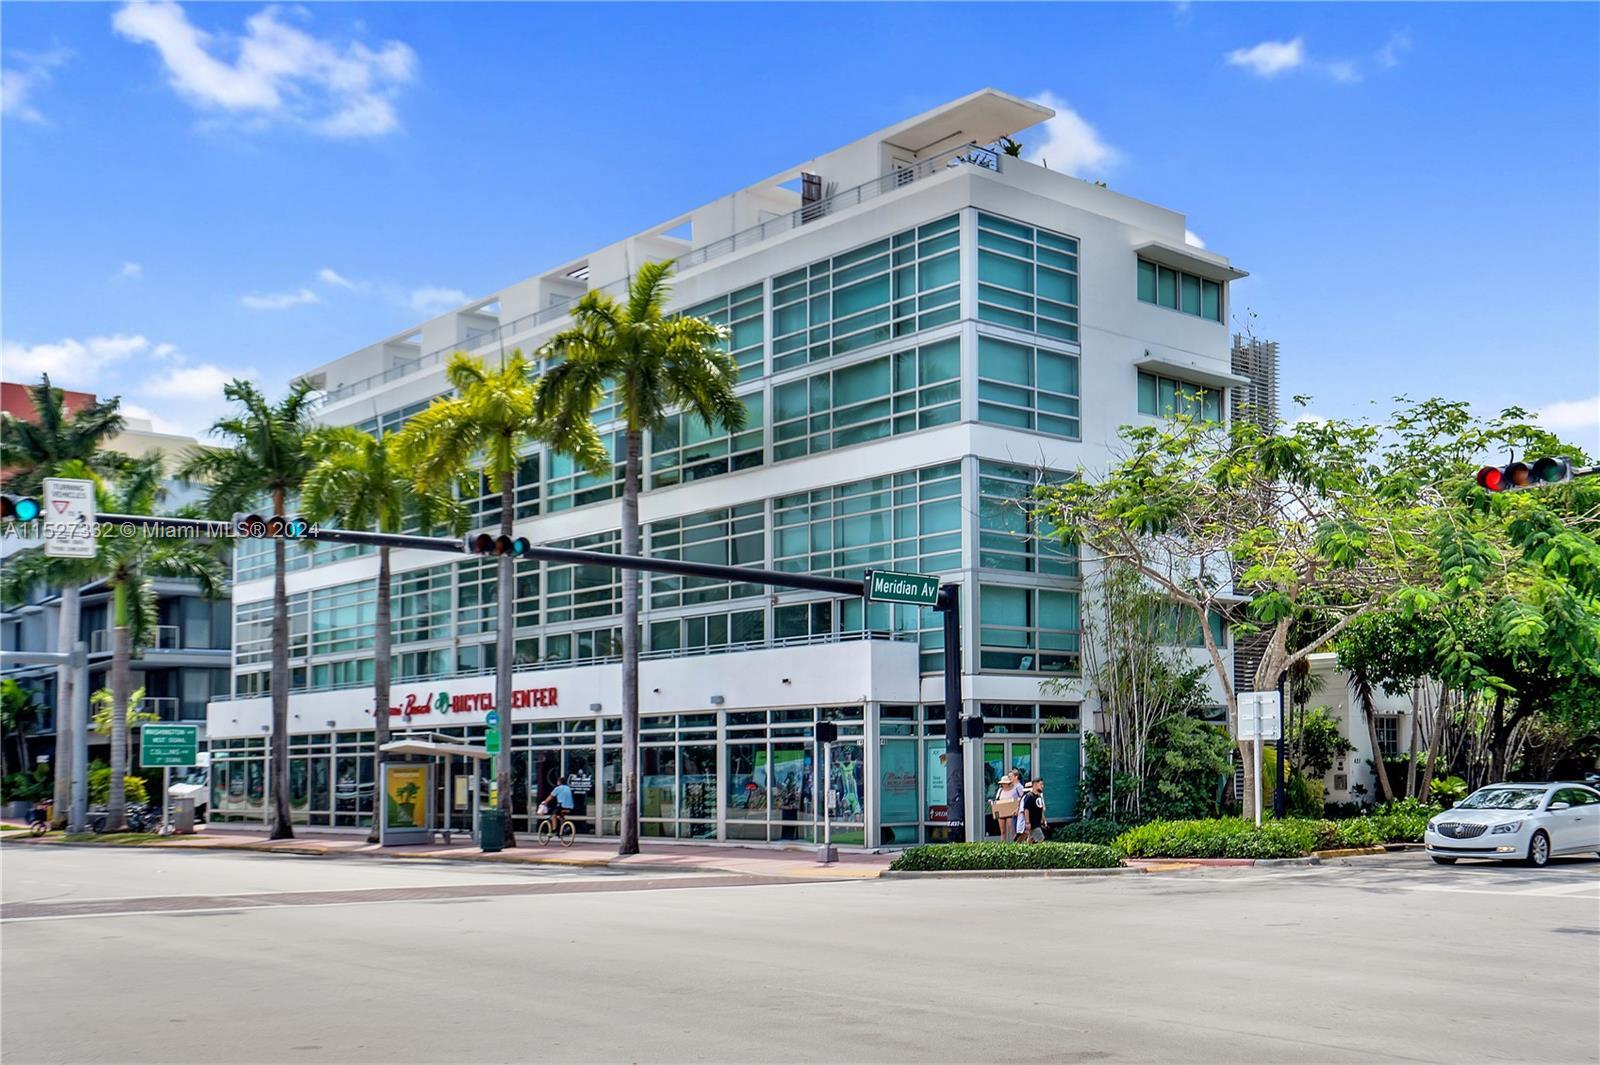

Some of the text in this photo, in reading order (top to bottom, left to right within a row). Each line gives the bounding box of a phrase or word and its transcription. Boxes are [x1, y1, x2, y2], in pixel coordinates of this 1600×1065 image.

[875, 578, 935, 597] Meridian Av
[452, 693, 496, 713] BICYCL
[511, 686, 558, 709] ENTER
